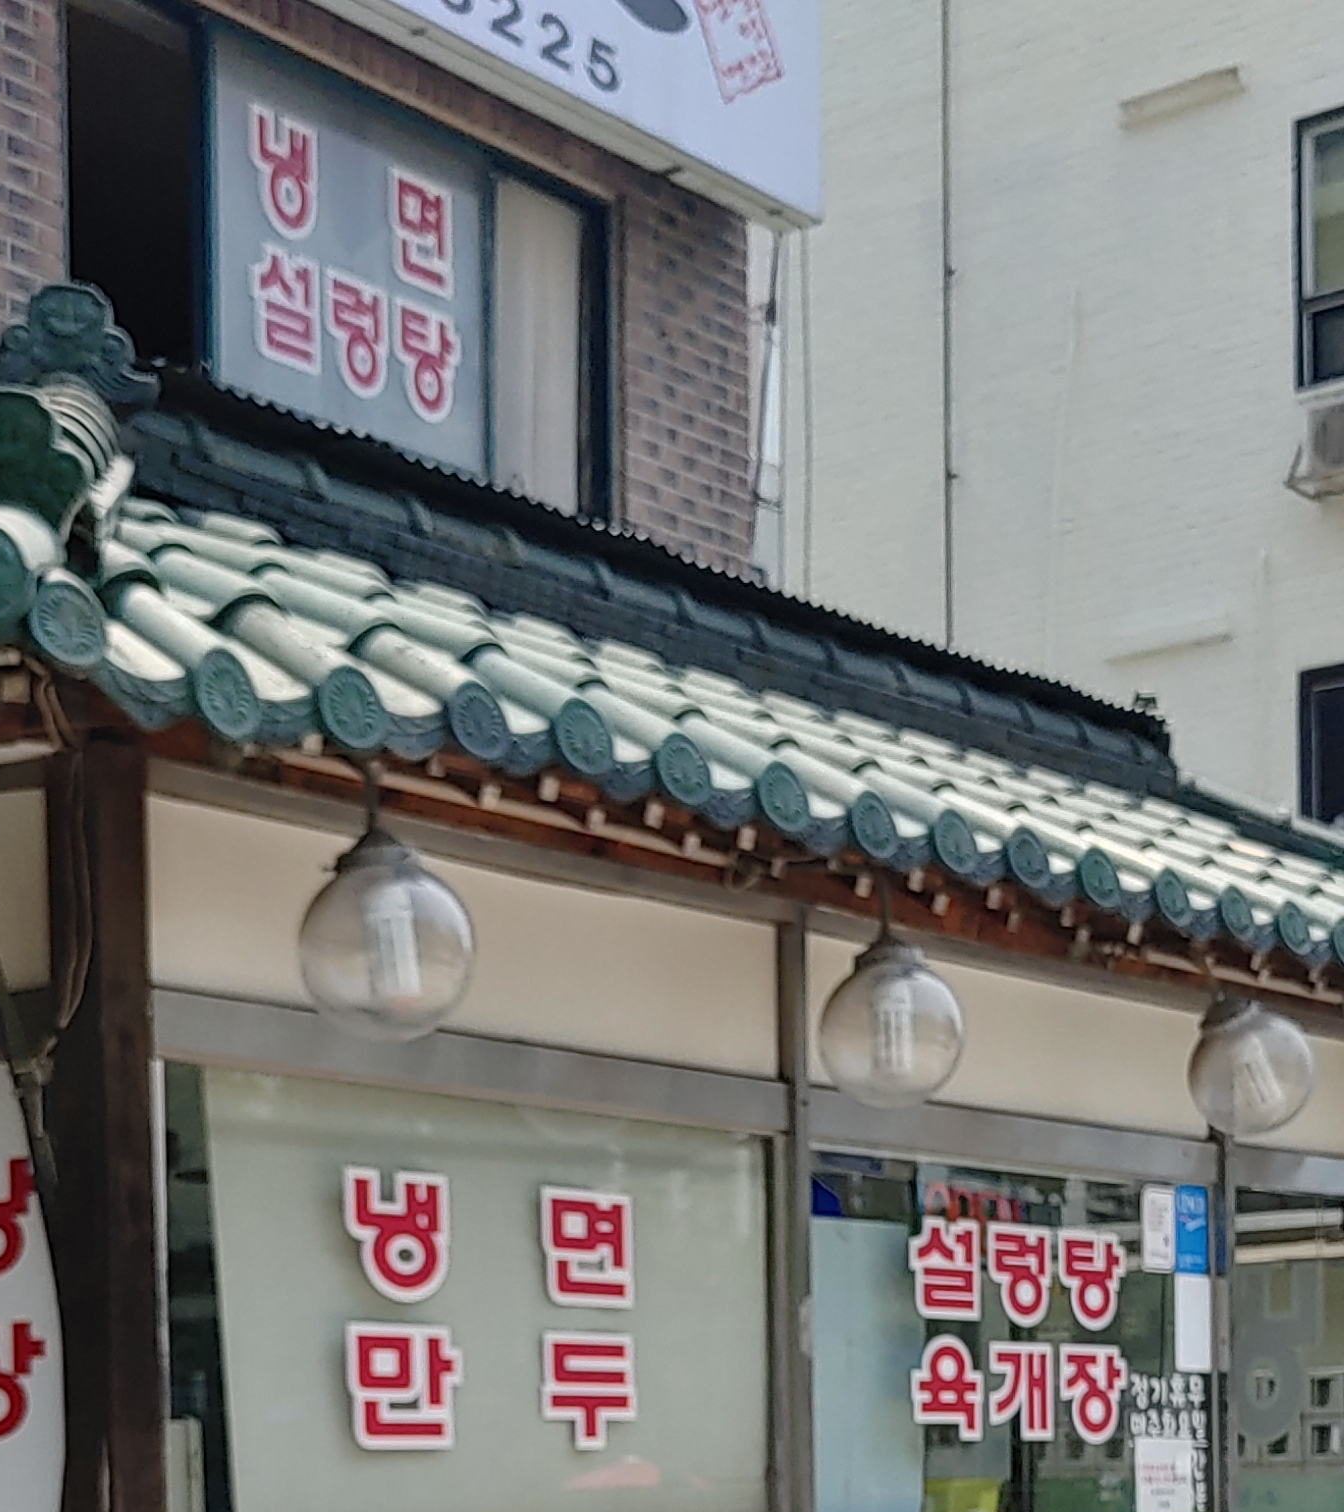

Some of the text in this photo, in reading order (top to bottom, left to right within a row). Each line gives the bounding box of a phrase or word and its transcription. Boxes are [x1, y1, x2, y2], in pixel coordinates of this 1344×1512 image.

[441, 0, 622, 93] 225
[250, 105, 453, 298] 냉면
[249, 244, 460, 422] 설렁탕
[346, 1168, 632, 1307] 냉면
[910, 1217, 1125, 1330] 설렁탕
[346, 1323, 636, 1449] 만두
[911, 1335, 1127, 1443] 육개장
